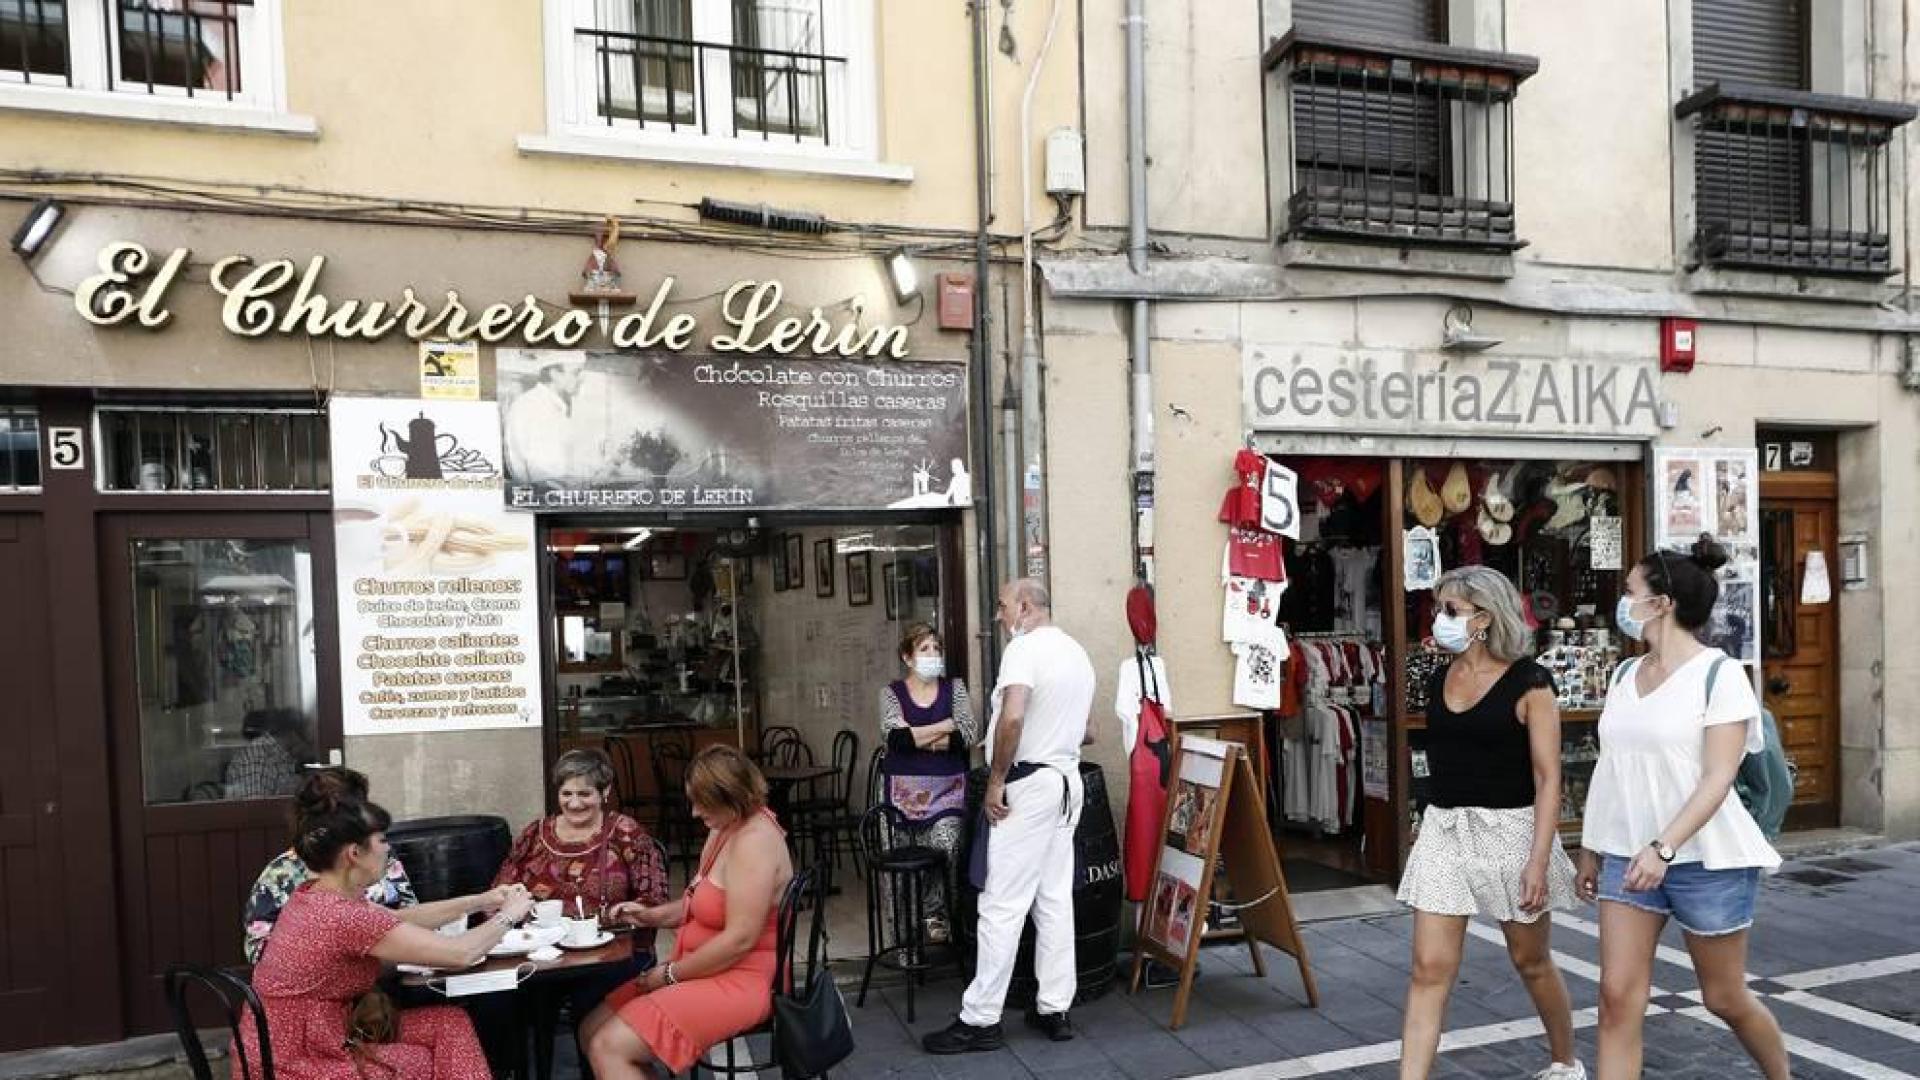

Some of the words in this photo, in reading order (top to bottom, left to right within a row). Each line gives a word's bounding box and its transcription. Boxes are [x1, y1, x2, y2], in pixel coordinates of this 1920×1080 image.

[74, 242, 189, 327] El
[210, 254, 594, 346] Churrero
[613, 276, 697, 350] de
[694, 363, 813, 385] Chocolate
[819, 370, 860, 386] con
[866, 368, 955, 388] Churros
[758, 391, 868, 412] Rosquillas
[874, 395, 947, 410] caseras
[54, 431, 80, 466] 5
[1768, 445, 1779, 468] 7
[512, 487, 540, 506] EL
[545, 489, 653, 506] CHURRERO
[660, 489, 686, 505] DE
[1263, 469, 1294, 530] 5
[354, 577, 434, 596] Churros
[438, 577, 523, 594] rellenos:
[403, 599, 425, 611] de
[376, 614, 452, 628] Chocolate
[467, 613, 503, 627] Nata
[361, 635, 436, 651] Churros
[438, 632, 519, 648] calientes
[356, 652, 451, 669] Chocolate
[454, 649, 526, 666] caliente
[372, 670, 442, 687] Patatas
[444, 670, 513, 685] caseras
[471, 686, 527, 699] batidos
[369, 706, 437, 720] Cervezas
[451, 702, 519, 716] refrescos
